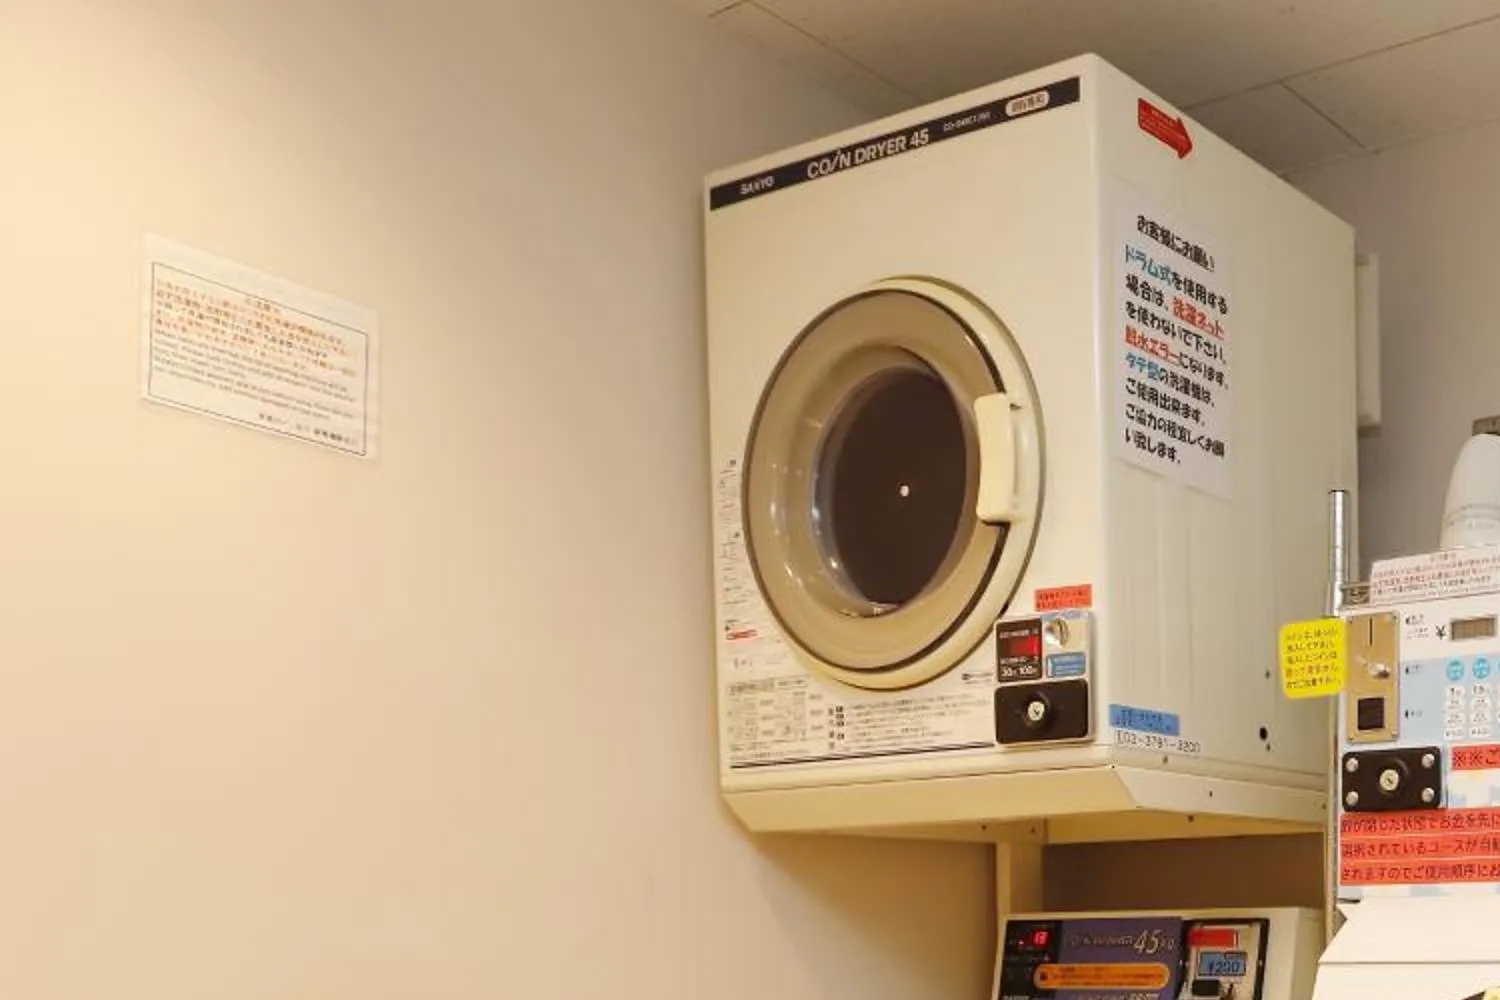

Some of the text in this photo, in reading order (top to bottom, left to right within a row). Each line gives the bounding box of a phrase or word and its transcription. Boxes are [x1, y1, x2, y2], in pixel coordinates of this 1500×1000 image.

[740, 175, 774, 195] SANYO
[855, 135, 908, 165] DRYER
[910, 128, 930, 147] 45
[1137, 215, 1215, 272] お客様にお願い
[1125, 244, 1228, 314] ドラム式を使用する
